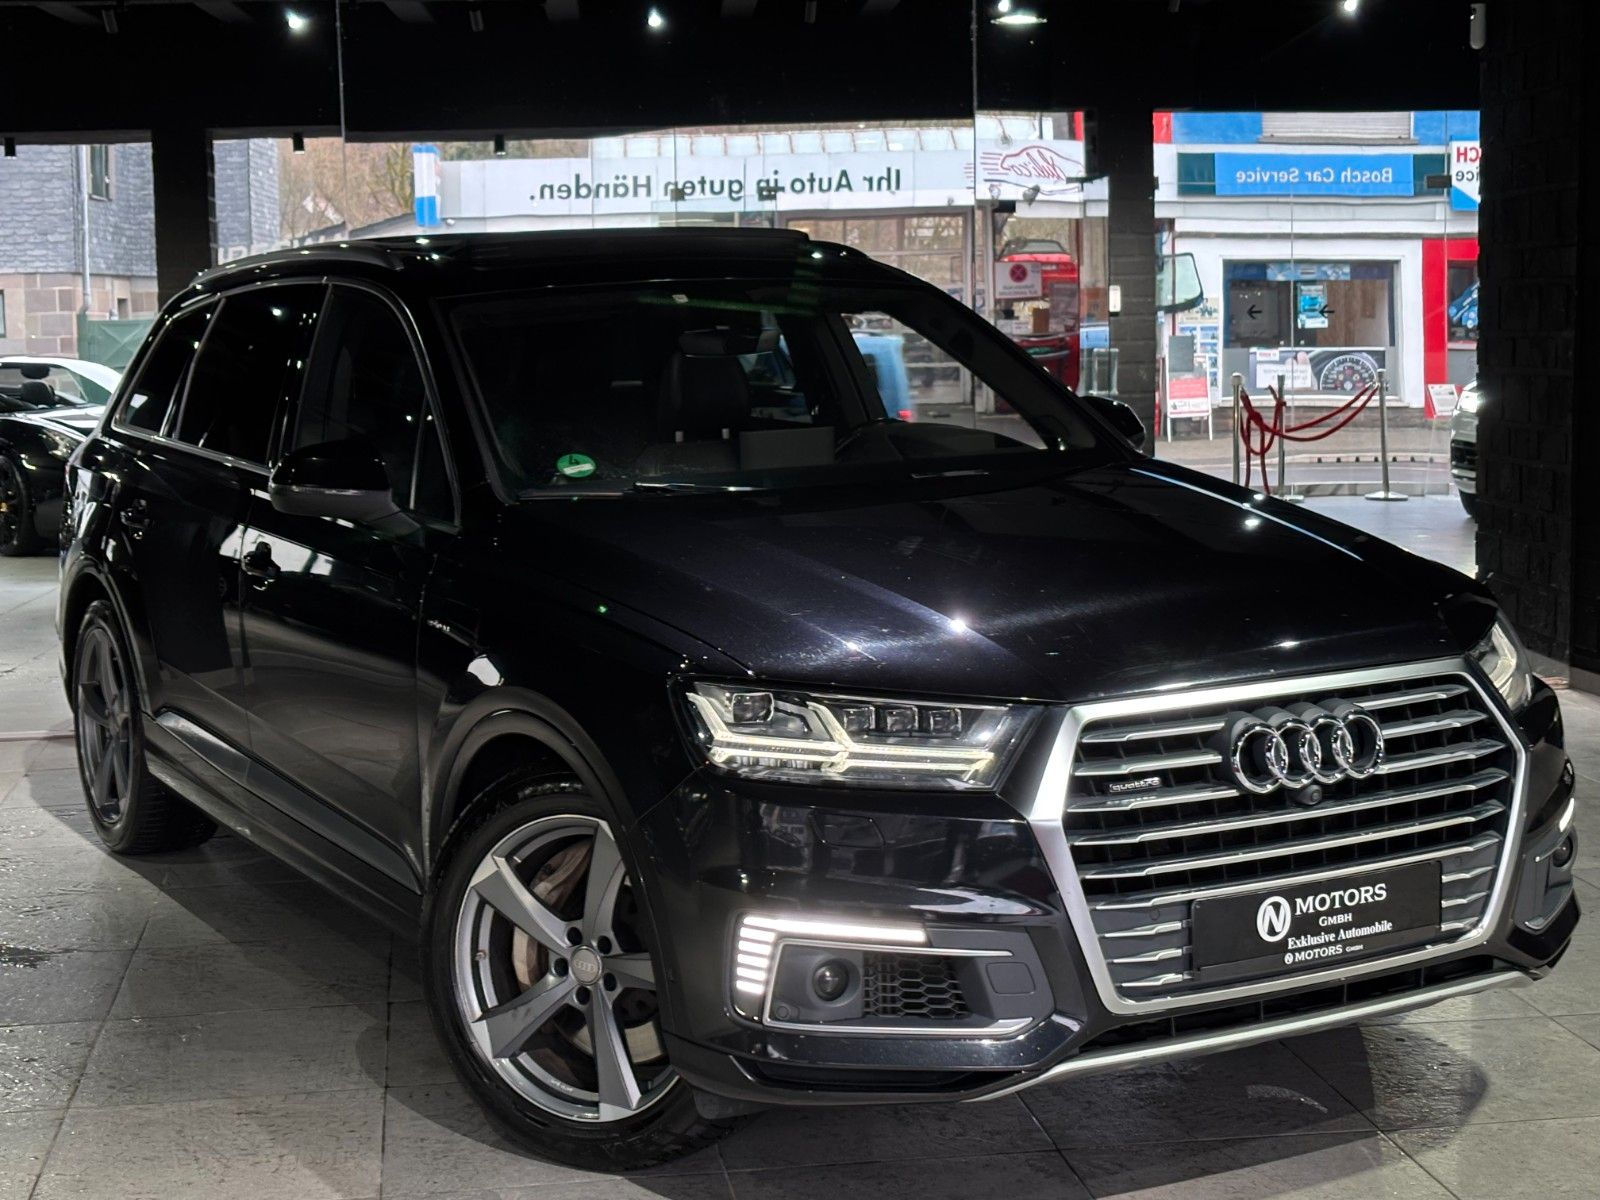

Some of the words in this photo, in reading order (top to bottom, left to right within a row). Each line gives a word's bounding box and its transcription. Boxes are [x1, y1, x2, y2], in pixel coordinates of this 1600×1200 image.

[1111, 778, 1160, 792] quattro
[1294, 883, 1388, 916] MOTORS
[1318, 912, 1353, 927] GMBH
[1287, 931, 1336, 950] Exklusive
[1337, 920, 1393, 944] Automobile
[1294, 944, 1343, 962] MOTORS
